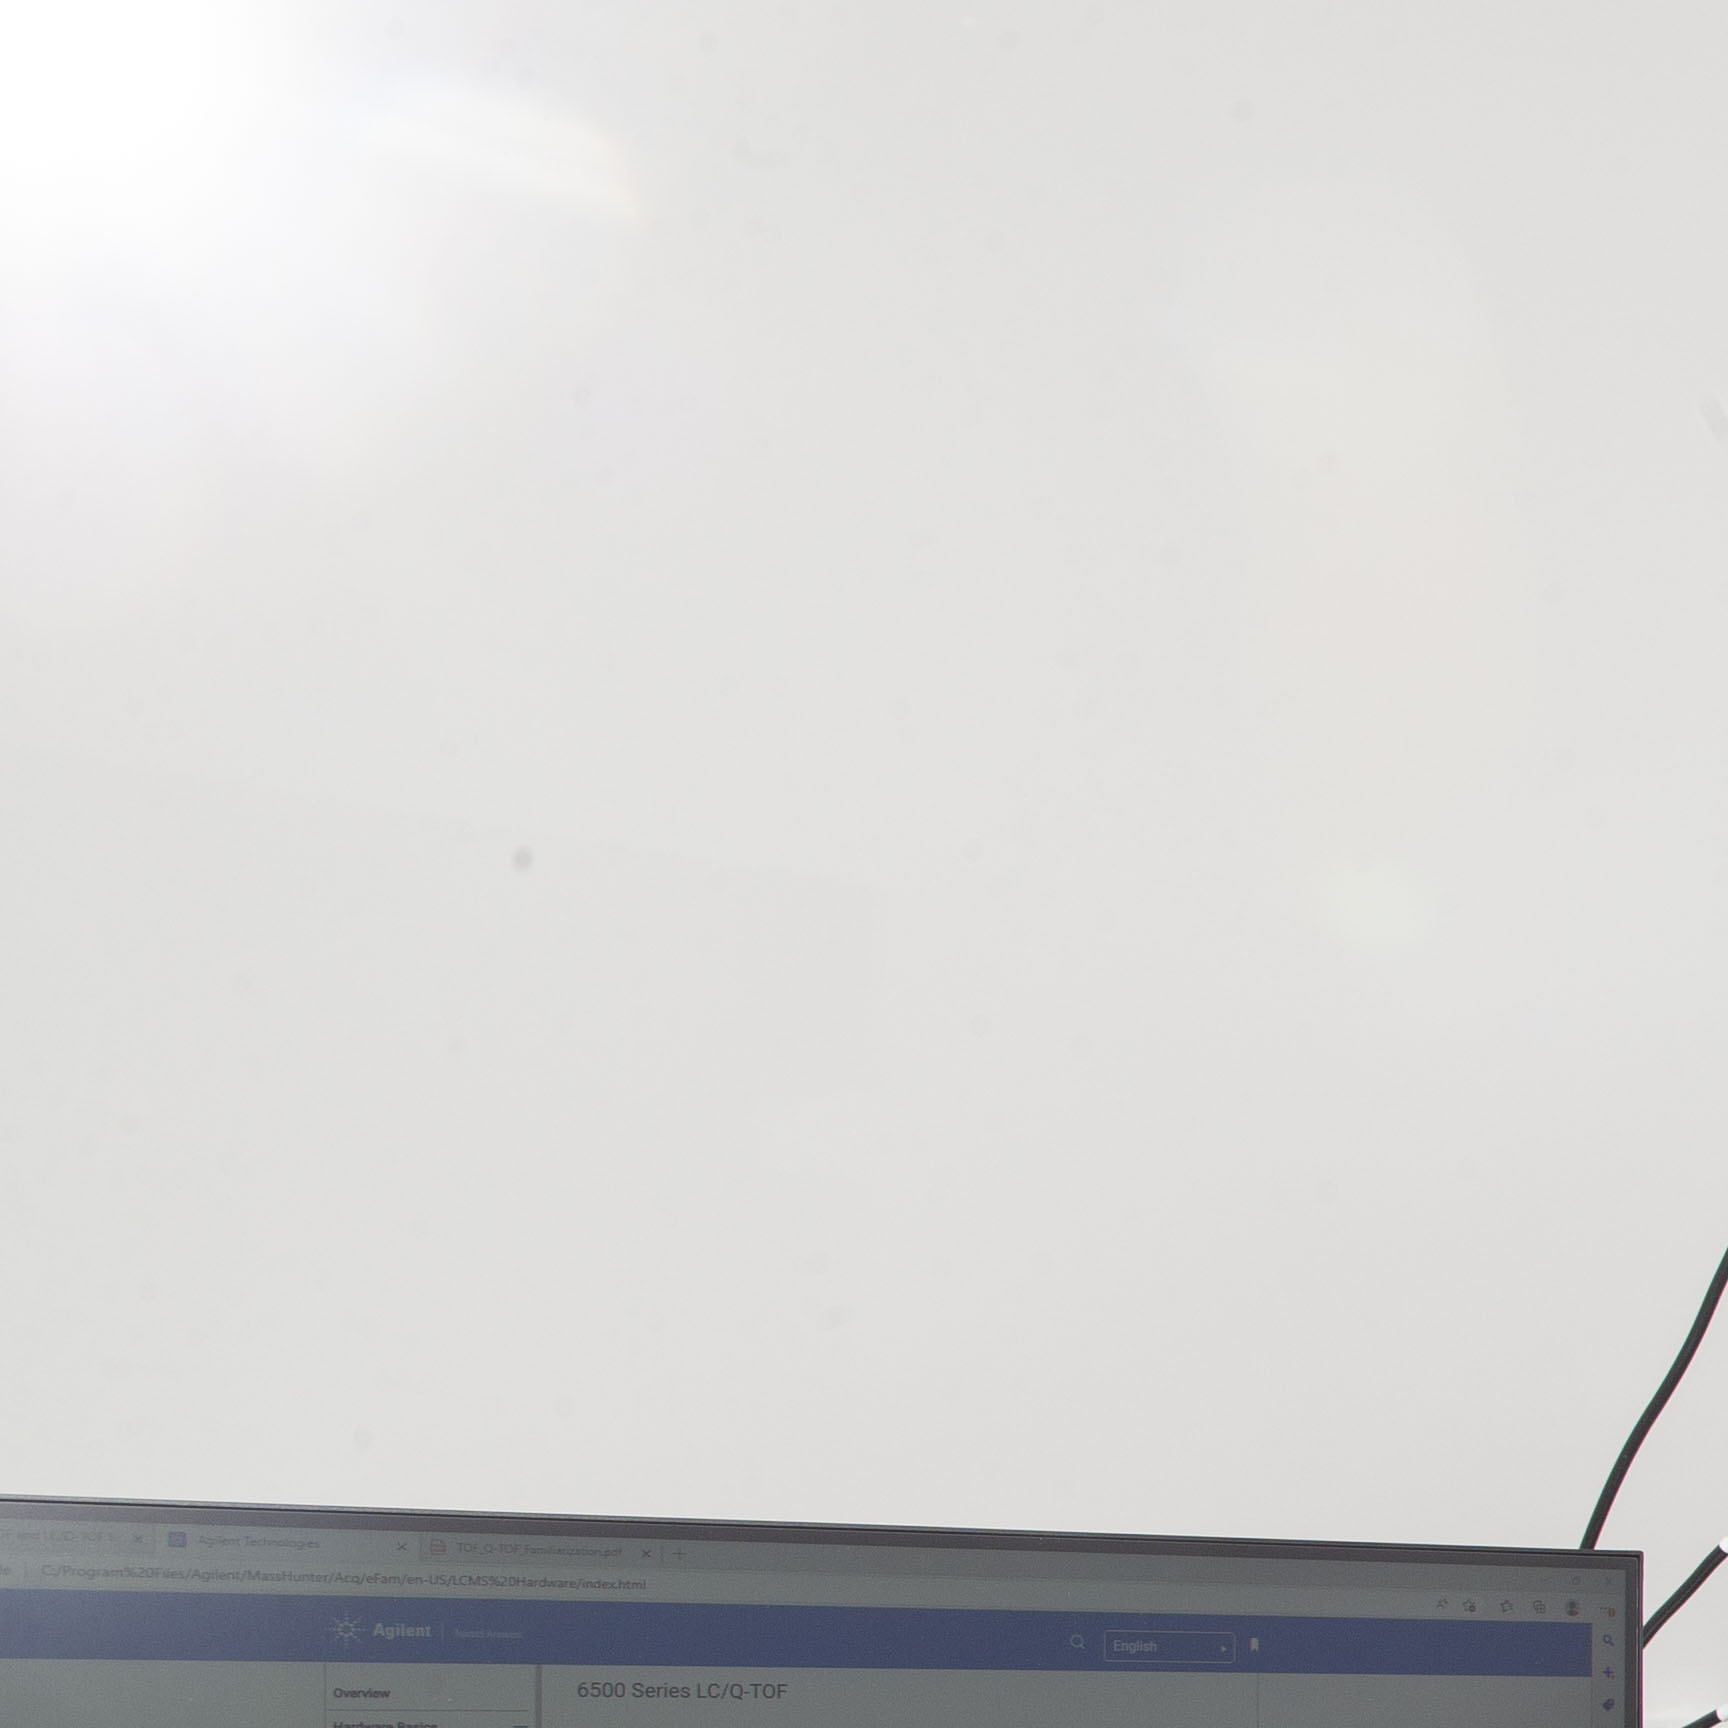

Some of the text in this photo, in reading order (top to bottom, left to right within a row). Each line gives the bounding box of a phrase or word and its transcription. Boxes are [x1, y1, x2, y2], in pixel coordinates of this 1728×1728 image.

[372, 1621, 432, 1641] Agilent
[1113, 1639, 1158, 1655] English
[333, 1687, 391, 1699] Overview
[577, 1681, 789, 1700] 6500 Series LC/Q-TOF
